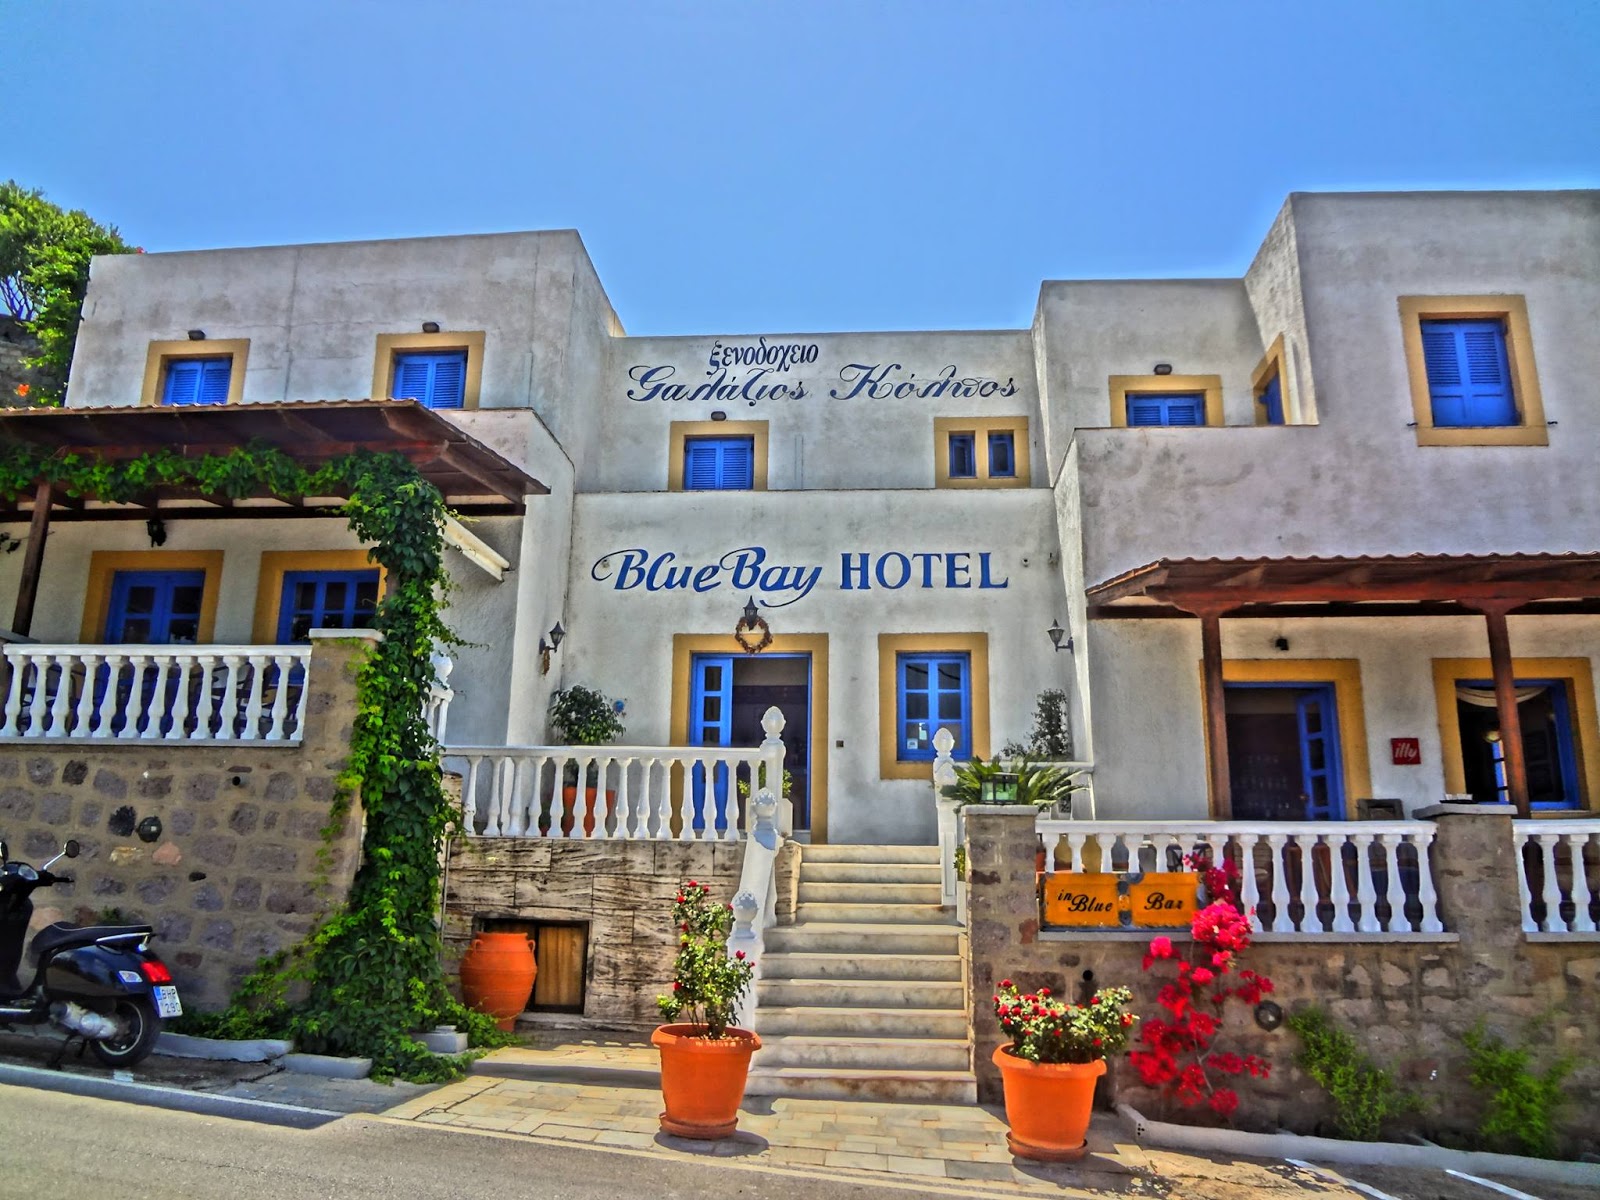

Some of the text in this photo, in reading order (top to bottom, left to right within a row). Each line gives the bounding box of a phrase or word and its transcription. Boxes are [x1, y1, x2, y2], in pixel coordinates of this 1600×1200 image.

[840, 551, 1009, 590] HOTEL
[1395, 742, 1417, 761] illy
[1057, 889, 1183, 912] in Blue Bar
